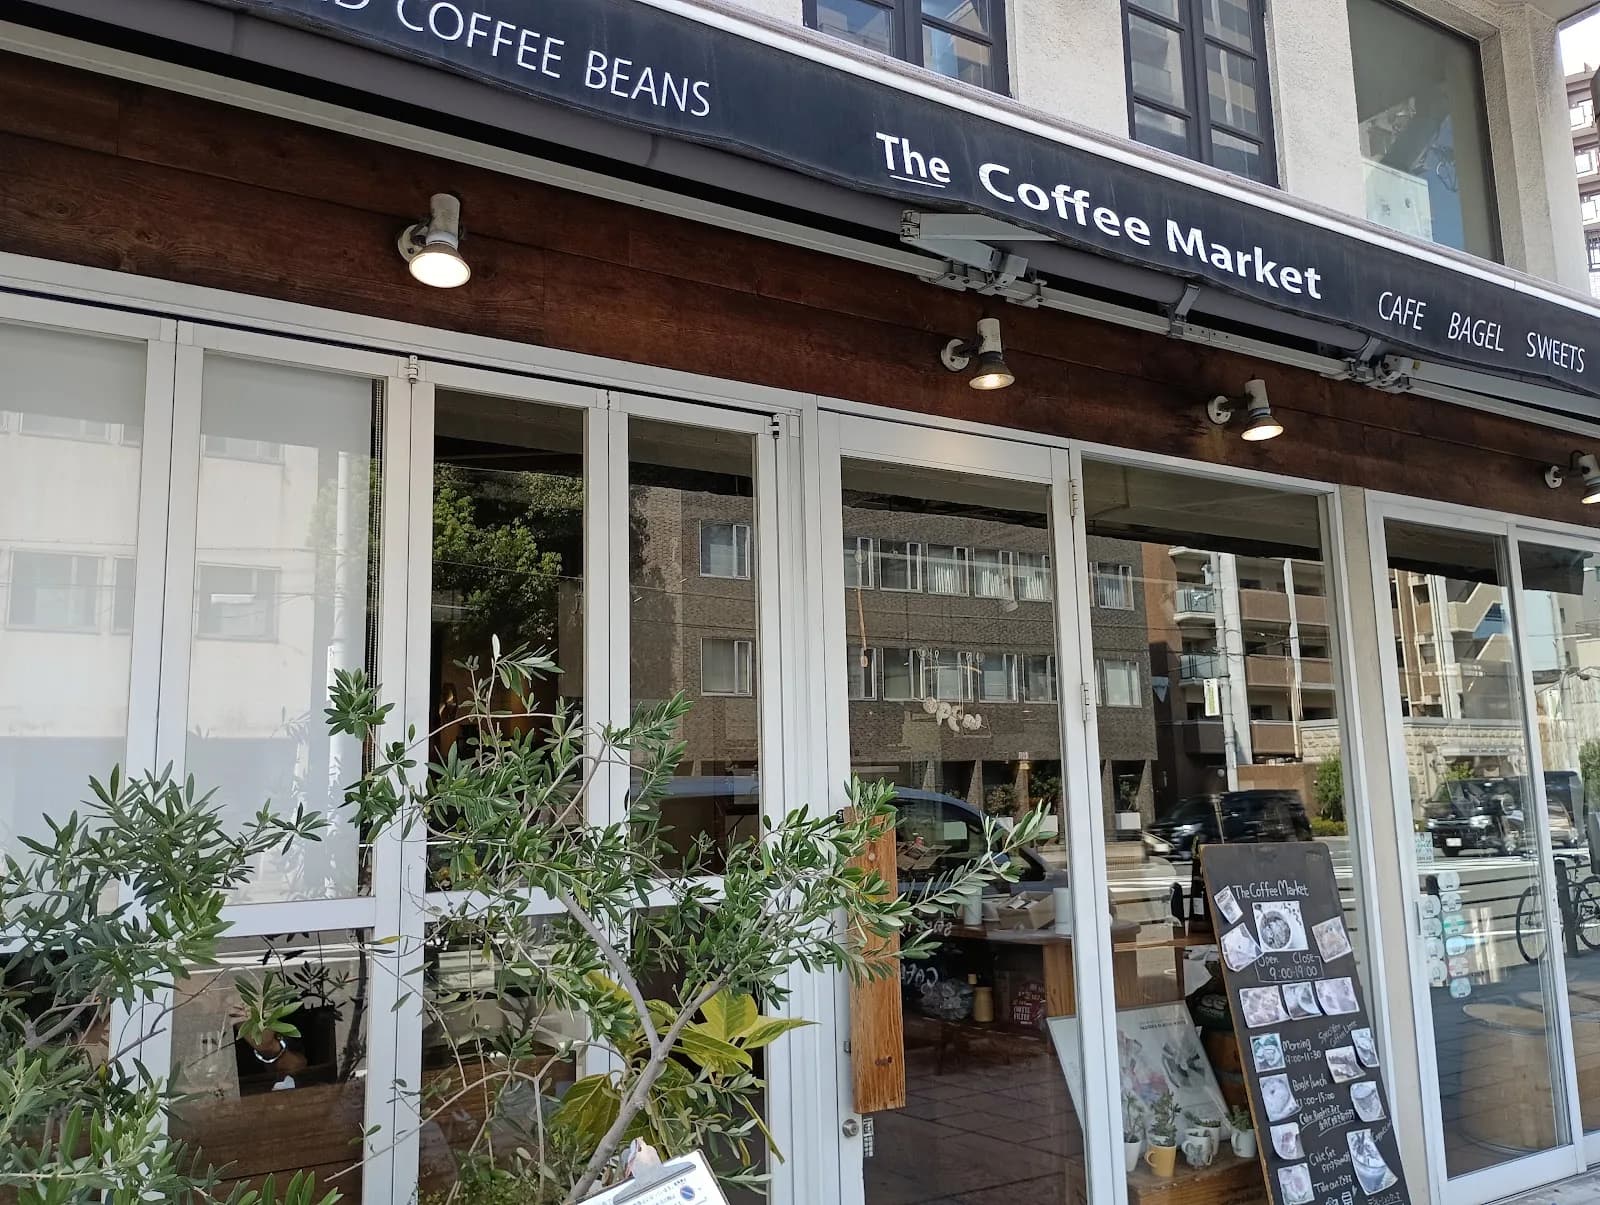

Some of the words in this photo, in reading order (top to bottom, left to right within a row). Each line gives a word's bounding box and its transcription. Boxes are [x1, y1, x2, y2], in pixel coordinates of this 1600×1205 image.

[397, 0, 565, 79] COFFEE
[585, 50, 711, 117] BEANS
[875, 132, 952, 185] The
[978, 163, 1152, 247] Coffee
[1165, 219, 1322, 300] Market
[1378, 291, 1427, 331] CAFE
[1447, 312, 1504, 352] BAGEL
[1526, 331, 1586, 373] SWEETS
